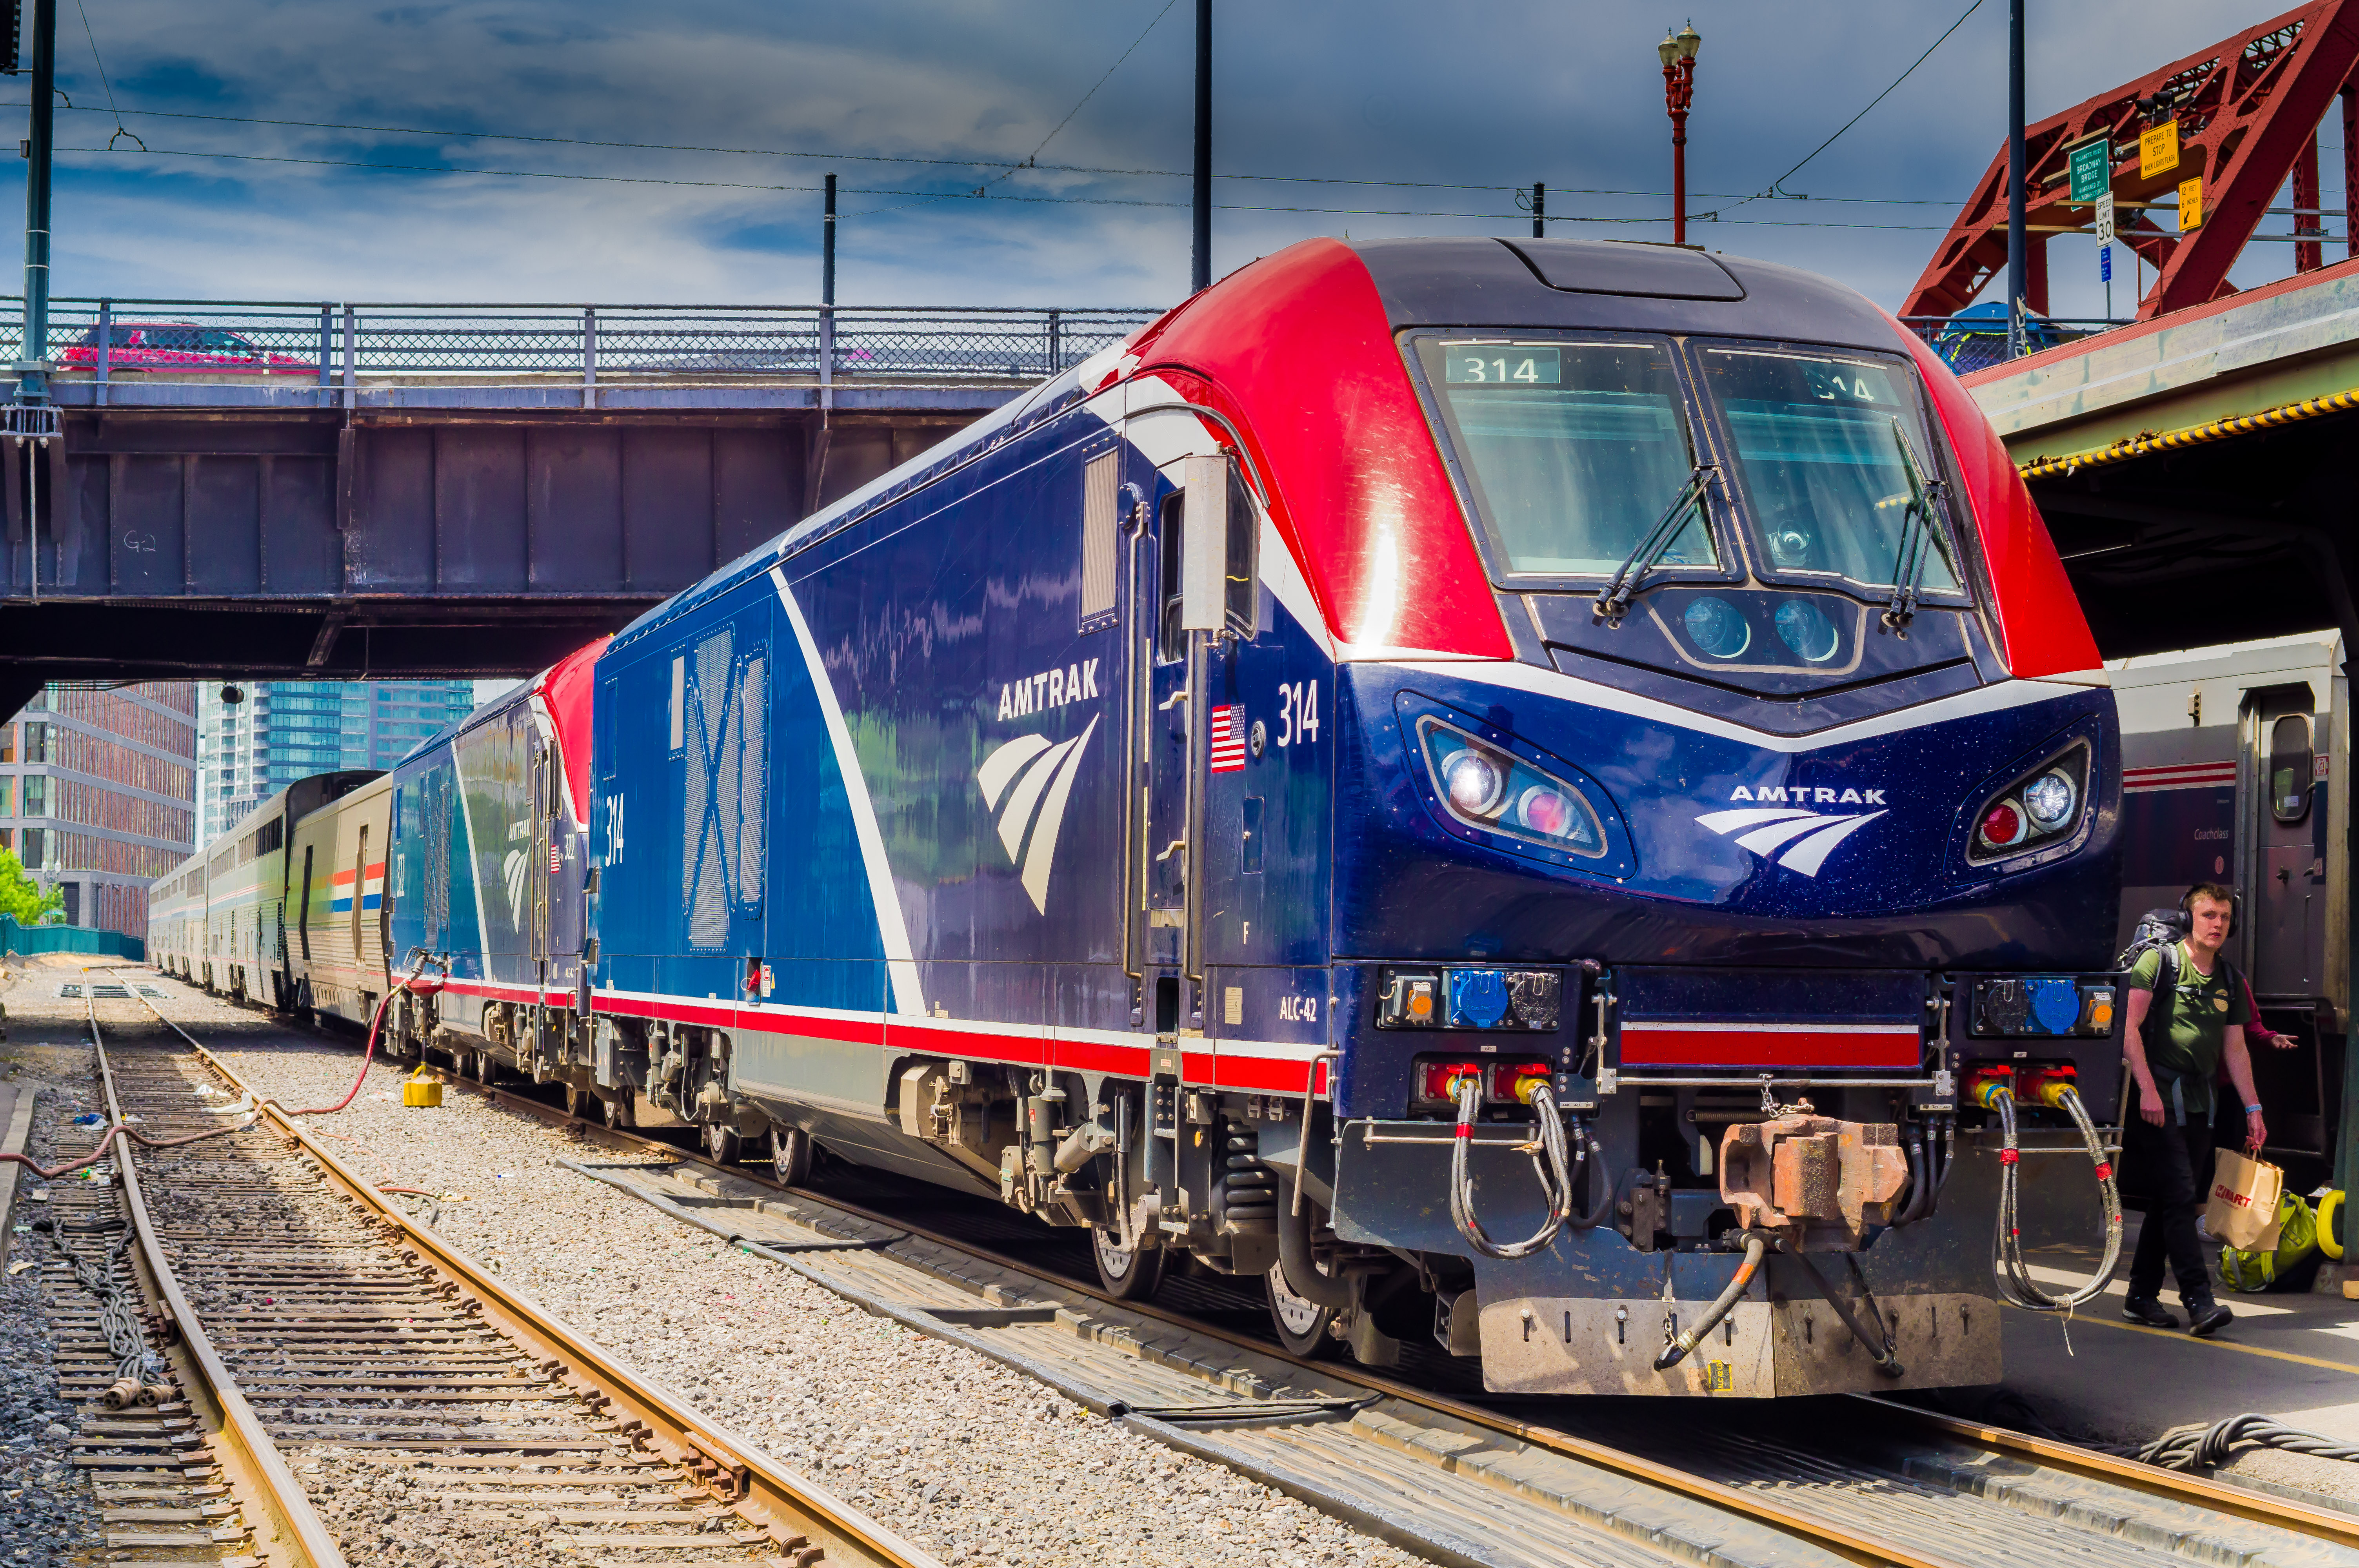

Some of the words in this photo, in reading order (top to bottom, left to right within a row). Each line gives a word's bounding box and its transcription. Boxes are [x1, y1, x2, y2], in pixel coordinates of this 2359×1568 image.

[2145, 131, 2164, 147] PREPARE
[2166, 129, 2172, 138] TO
[2153, 143, 2165, 156] STOP
[2077, 158, 2102, 174] BROADWAY
[2145, 163, 2153, 172] WHEN
[2154, 158, 2164, 169] LIGHTS
[2165, 154, 2175, 164] FLASH
[2081, 169, 2098, 183] BRIDGE
[2182, 187, 2186, 196] 12
[2097, 198, 2112, 211] SPEED
[2182, 200, 2185, 208] 6
[2187, 197, 2198, 205] INCHES
[2099, 209, 2110, 221] LIMIT
[2099, 220, 2112, 241] 30
[1464, 358, 1539, 382] 314
[998, 658, 1099, 722] AMTRAK
[1278, 679, 1319, 747] 314
[1730, 786, 1886, 804] AMTRAK
[509, 818, 530, 842] AMTRAK
[605, 793, 624, 866] 314
[564, 833, 575, 860] 322
[1243, 921, 1250, 945] F
[1279, 996, 1316, 1022] ALC-42
